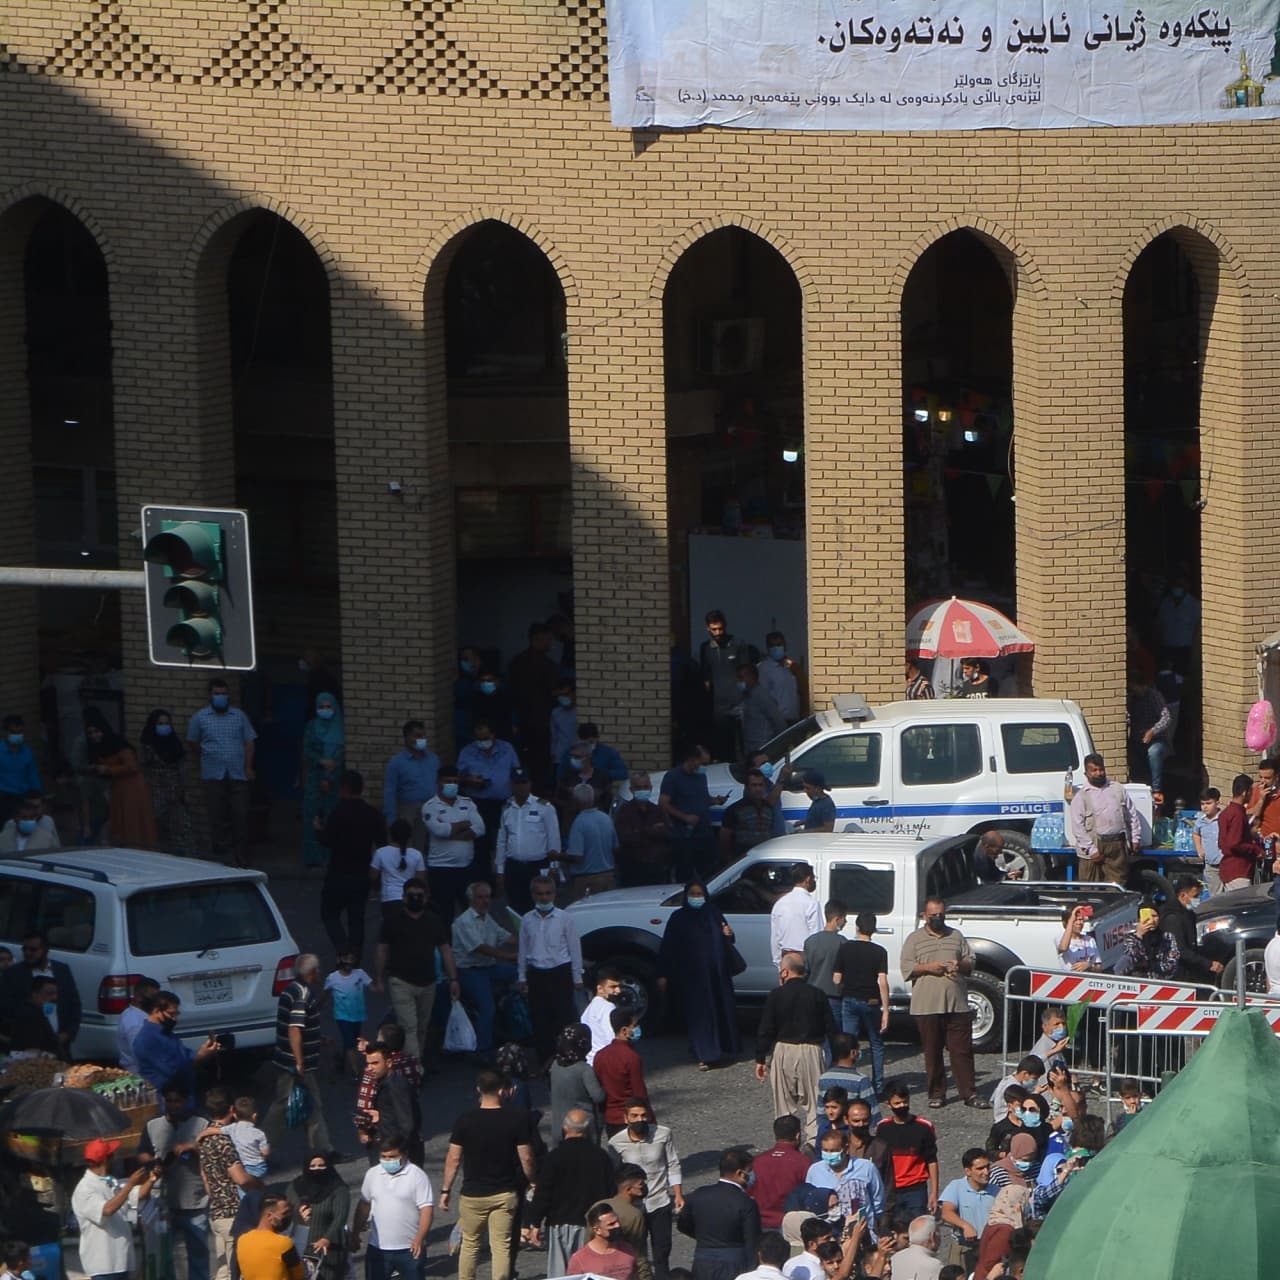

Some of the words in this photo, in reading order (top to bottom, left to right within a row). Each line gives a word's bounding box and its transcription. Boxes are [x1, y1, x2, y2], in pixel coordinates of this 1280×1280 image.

[1006, 11, 1072, 54] ئایین
[1083, 9, 1147, 52] ژیانی
[1158, 9, 1233, 53] پێکەوە
[975, 25, 993, 53] و
[953, 73, 993, 89] هەولێر
[997, 71, 1042, 88] پارێزگای
[711, 94, 745, 104] محمد
[747, 91, 801, 107] پێغەمبەر
[804, 93, 842, 106] بوونی
[845, 92, 875, 107] دایک
[879, 92, 892, 105] لە
[896, 92, 969, 107] یادکردنەوەی
[972, 88, 1001, 106] باڵای
[1004, 90, 1042, 106] لێژنەی
[1000, 803, 1051, 814] POLICE
[859, 816, 895, 824] TRAFFIC
[1088, 981, 1104, 989] CITY
